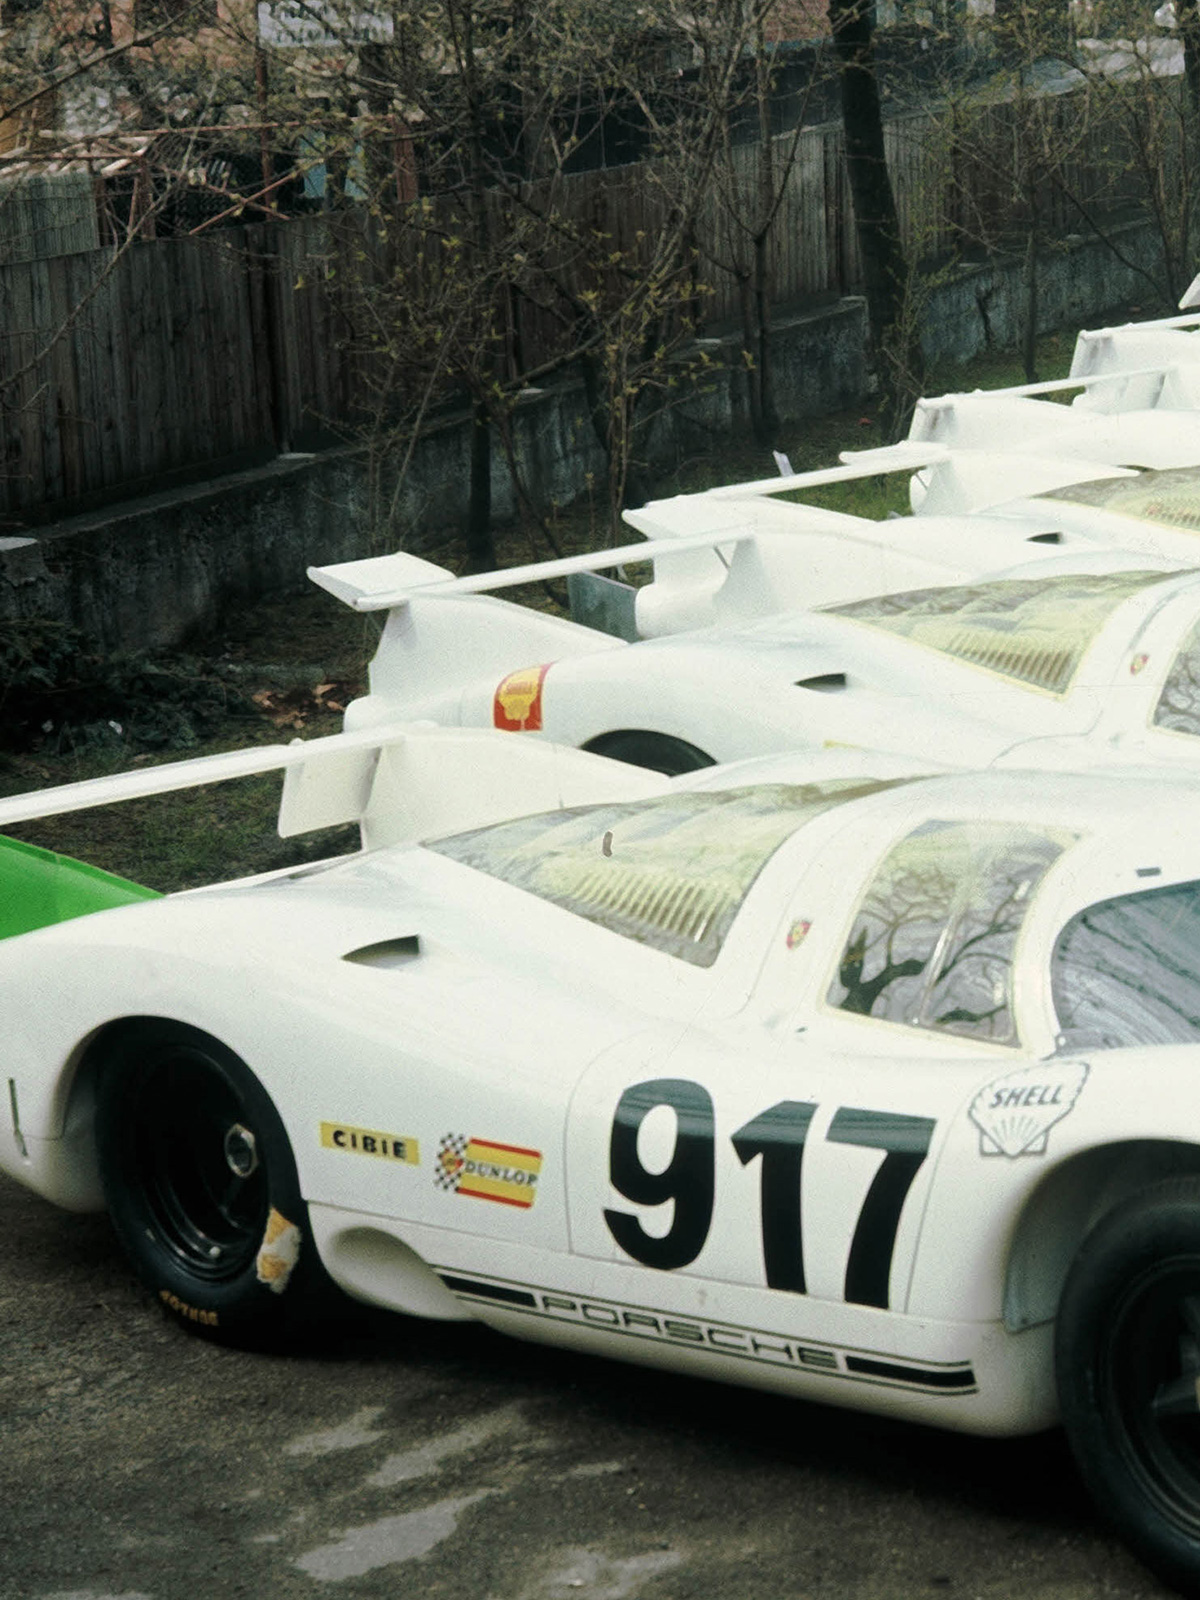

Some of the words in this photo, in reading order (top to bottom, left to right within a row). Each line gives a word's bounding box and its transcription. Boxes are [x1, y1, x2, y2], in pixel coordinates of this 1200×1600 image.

[989, 1085, 1063, 1108] SHELL
[332, 1129, 406, 1159] CIBIE
[465, 1160, 538, 1185] DUNLOP
[603, 1078, 937, 1310] 917
[542, 1295, 839, 1370] PORSCHE
